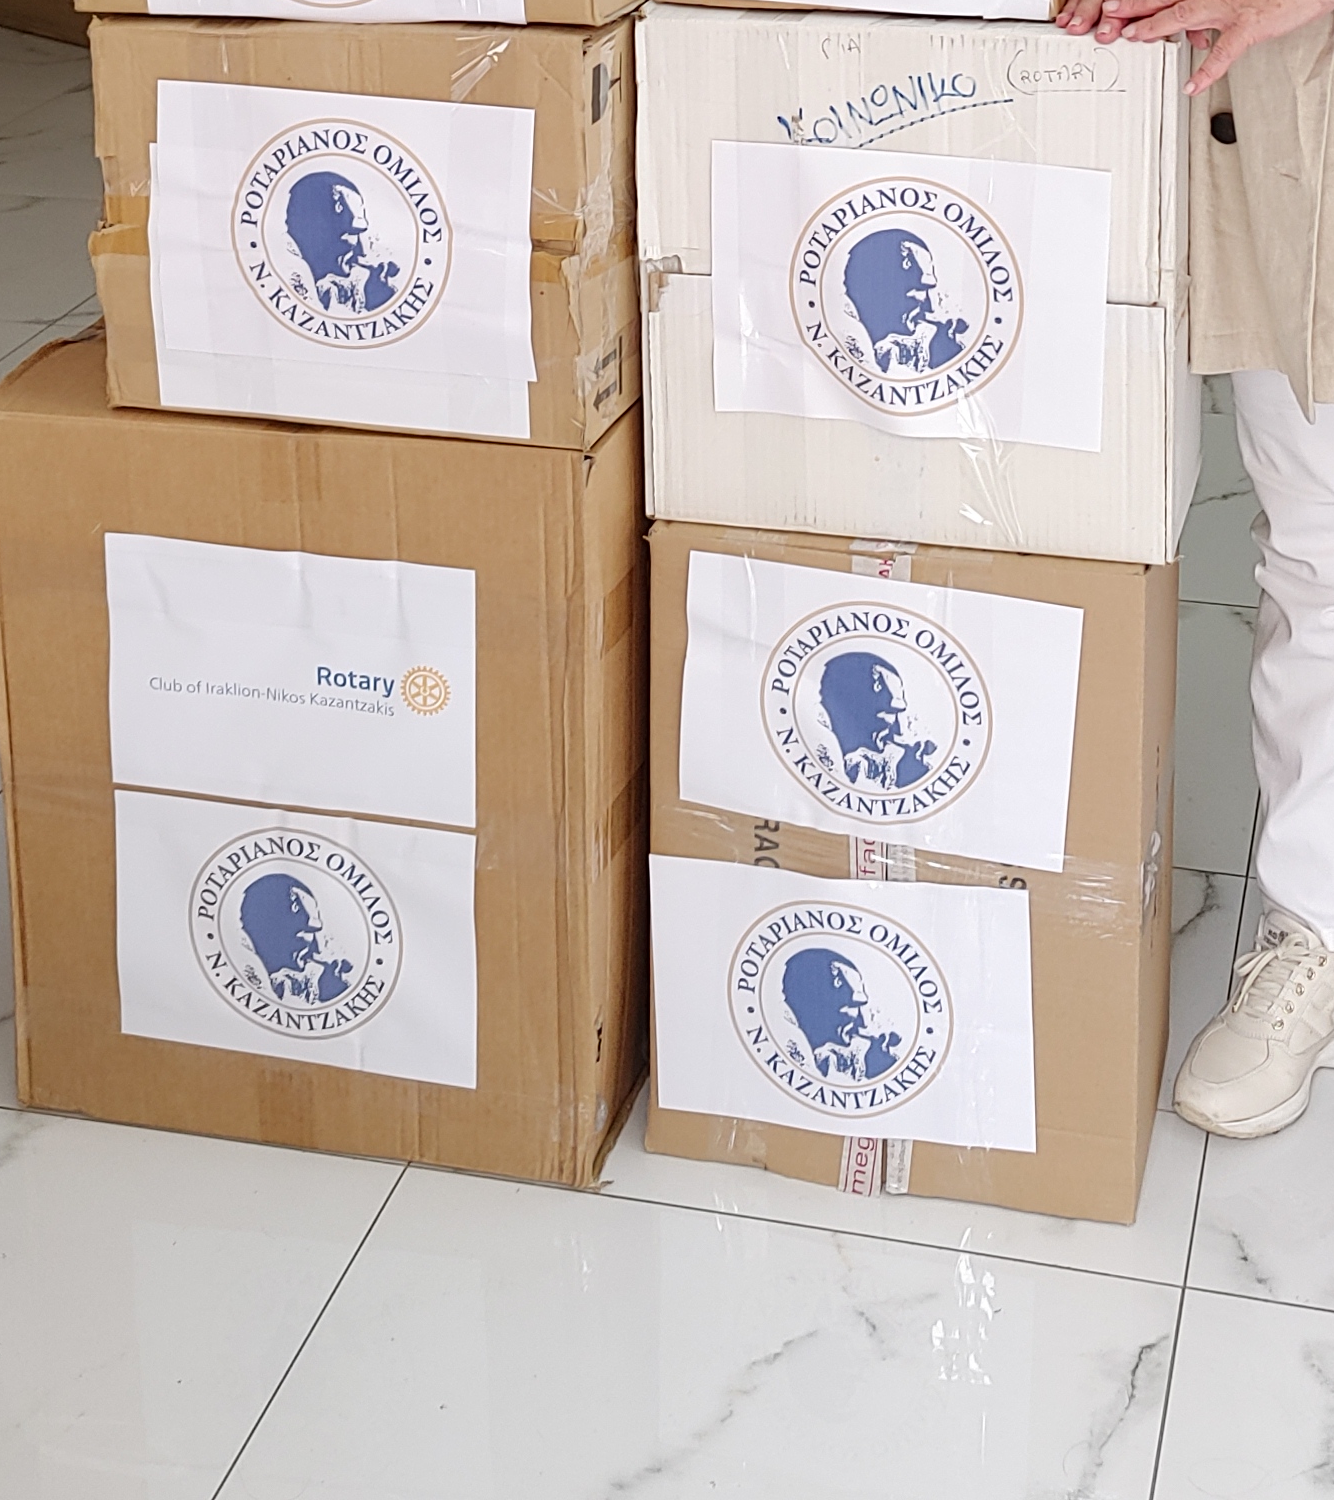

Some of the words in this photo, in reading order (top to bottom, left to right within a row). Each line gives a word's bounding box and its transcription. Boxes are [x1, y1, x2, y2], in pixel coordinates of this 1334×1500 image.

[241, 129, 369, 228] ΡΟΤΑΡΙΑΝΟΣ
[373, 144, 442, 243] ΟΜΙΛΟΣ
[800, 187, 938, 285] ΡΟΤΑΡΙΑΝΟΣ
[943, 202, 1013, 302] ΟΜΙΛΟΣ
[249, 261, 273, 288] Ν.
[268, 277, 434, 340] ΚΑΖΑΝΤΖΑΚΗΣ
[806, 322, 828, 348] Ν.
[826, 334, 1004, 406] ΚΑΖΑΝΤΖΑΚΗΣ
[149, 676, 183, 693] Club
[186, 680, 204, 694] of
[206, 681, 306, 705] Iraklion-Nikos
[310, 692, 395, 717] Kazantzakis
[316, 666, 395, 698] Rotary
[771, 612, 910, 695] ΡΟΤΑΡΙΑΝΟΣ
[915, 629, 982, 726] ΟΜΙΛΟΣ
[777, 727, 799, 753] Ν.
[793, 755, 971, 816] ΚΑΖΑΝΤΖΑΚΗΣ
[198, 836, 321, 920] ΡΟΤΑΡΙΑΝΟΣ
[326, 853, 393, 945] ΟΜΙΛΟΣ
[205, 950, 228, 978] Ν.
[224, 975, 385, 1031] ΚΑΖΑΝΤΖΑΚΗΣ
[738, 910, 864, 994] ΡΟΤΑΡΙΑΝΟΣ
[869, 924, 943, 1014] ΟΜΙΛΟΣ
[746, 1026, 769, 1053] Ν.
[765, 1045, 937, 1109] ΚΑΖΑΝΤΖΑΚΗΣ
[851, 1137, 875, 1195] meg
